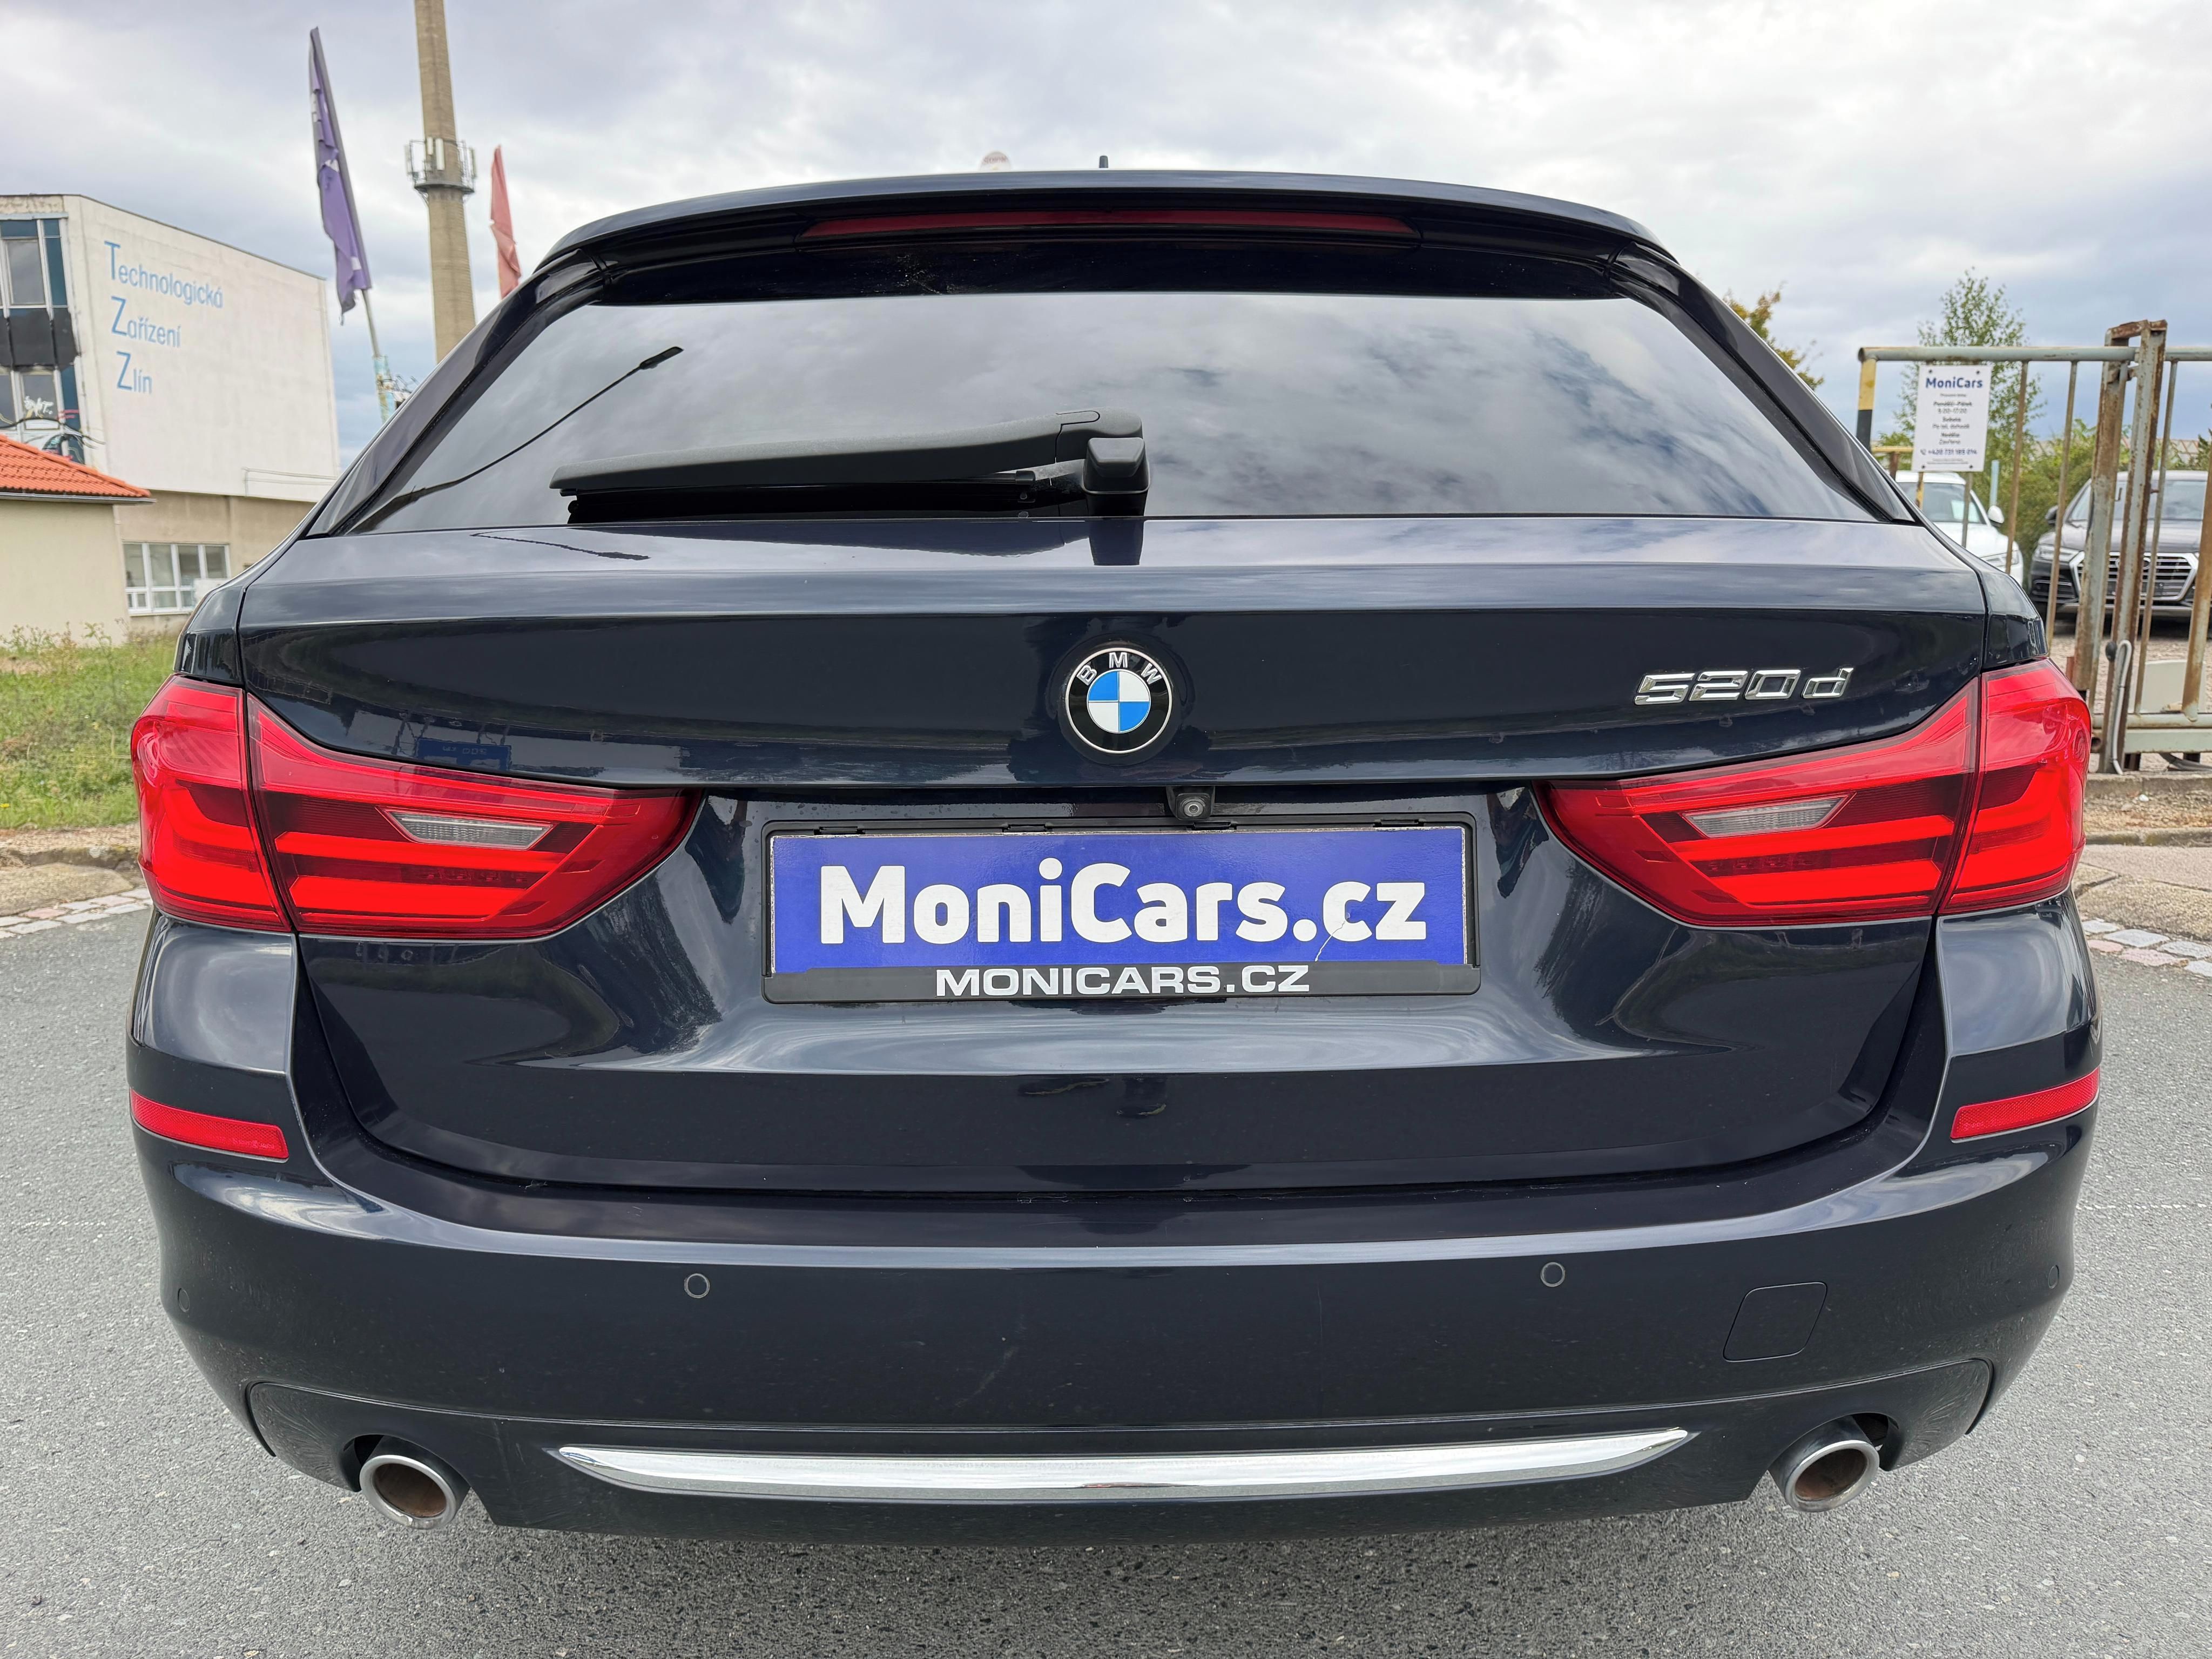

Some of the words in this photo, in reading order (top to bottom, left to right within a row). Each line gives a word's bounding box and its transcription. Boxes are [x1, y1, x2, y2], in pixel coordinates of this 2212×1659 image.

[104, 240, 223, 309] Technologická
[111, 296, 181, 348] Zařízení
[116, 351, 152, 394] Zlín
[1925, 376, 1983, 388] MoniCars
[1076, 652, 1162, 685] BMW
[1635, 667, 1854, 705] 520d
[820, 857, 1426, 944] MoniCars.cz
[936, 965, 1310, 997] MONICARS.CZ
